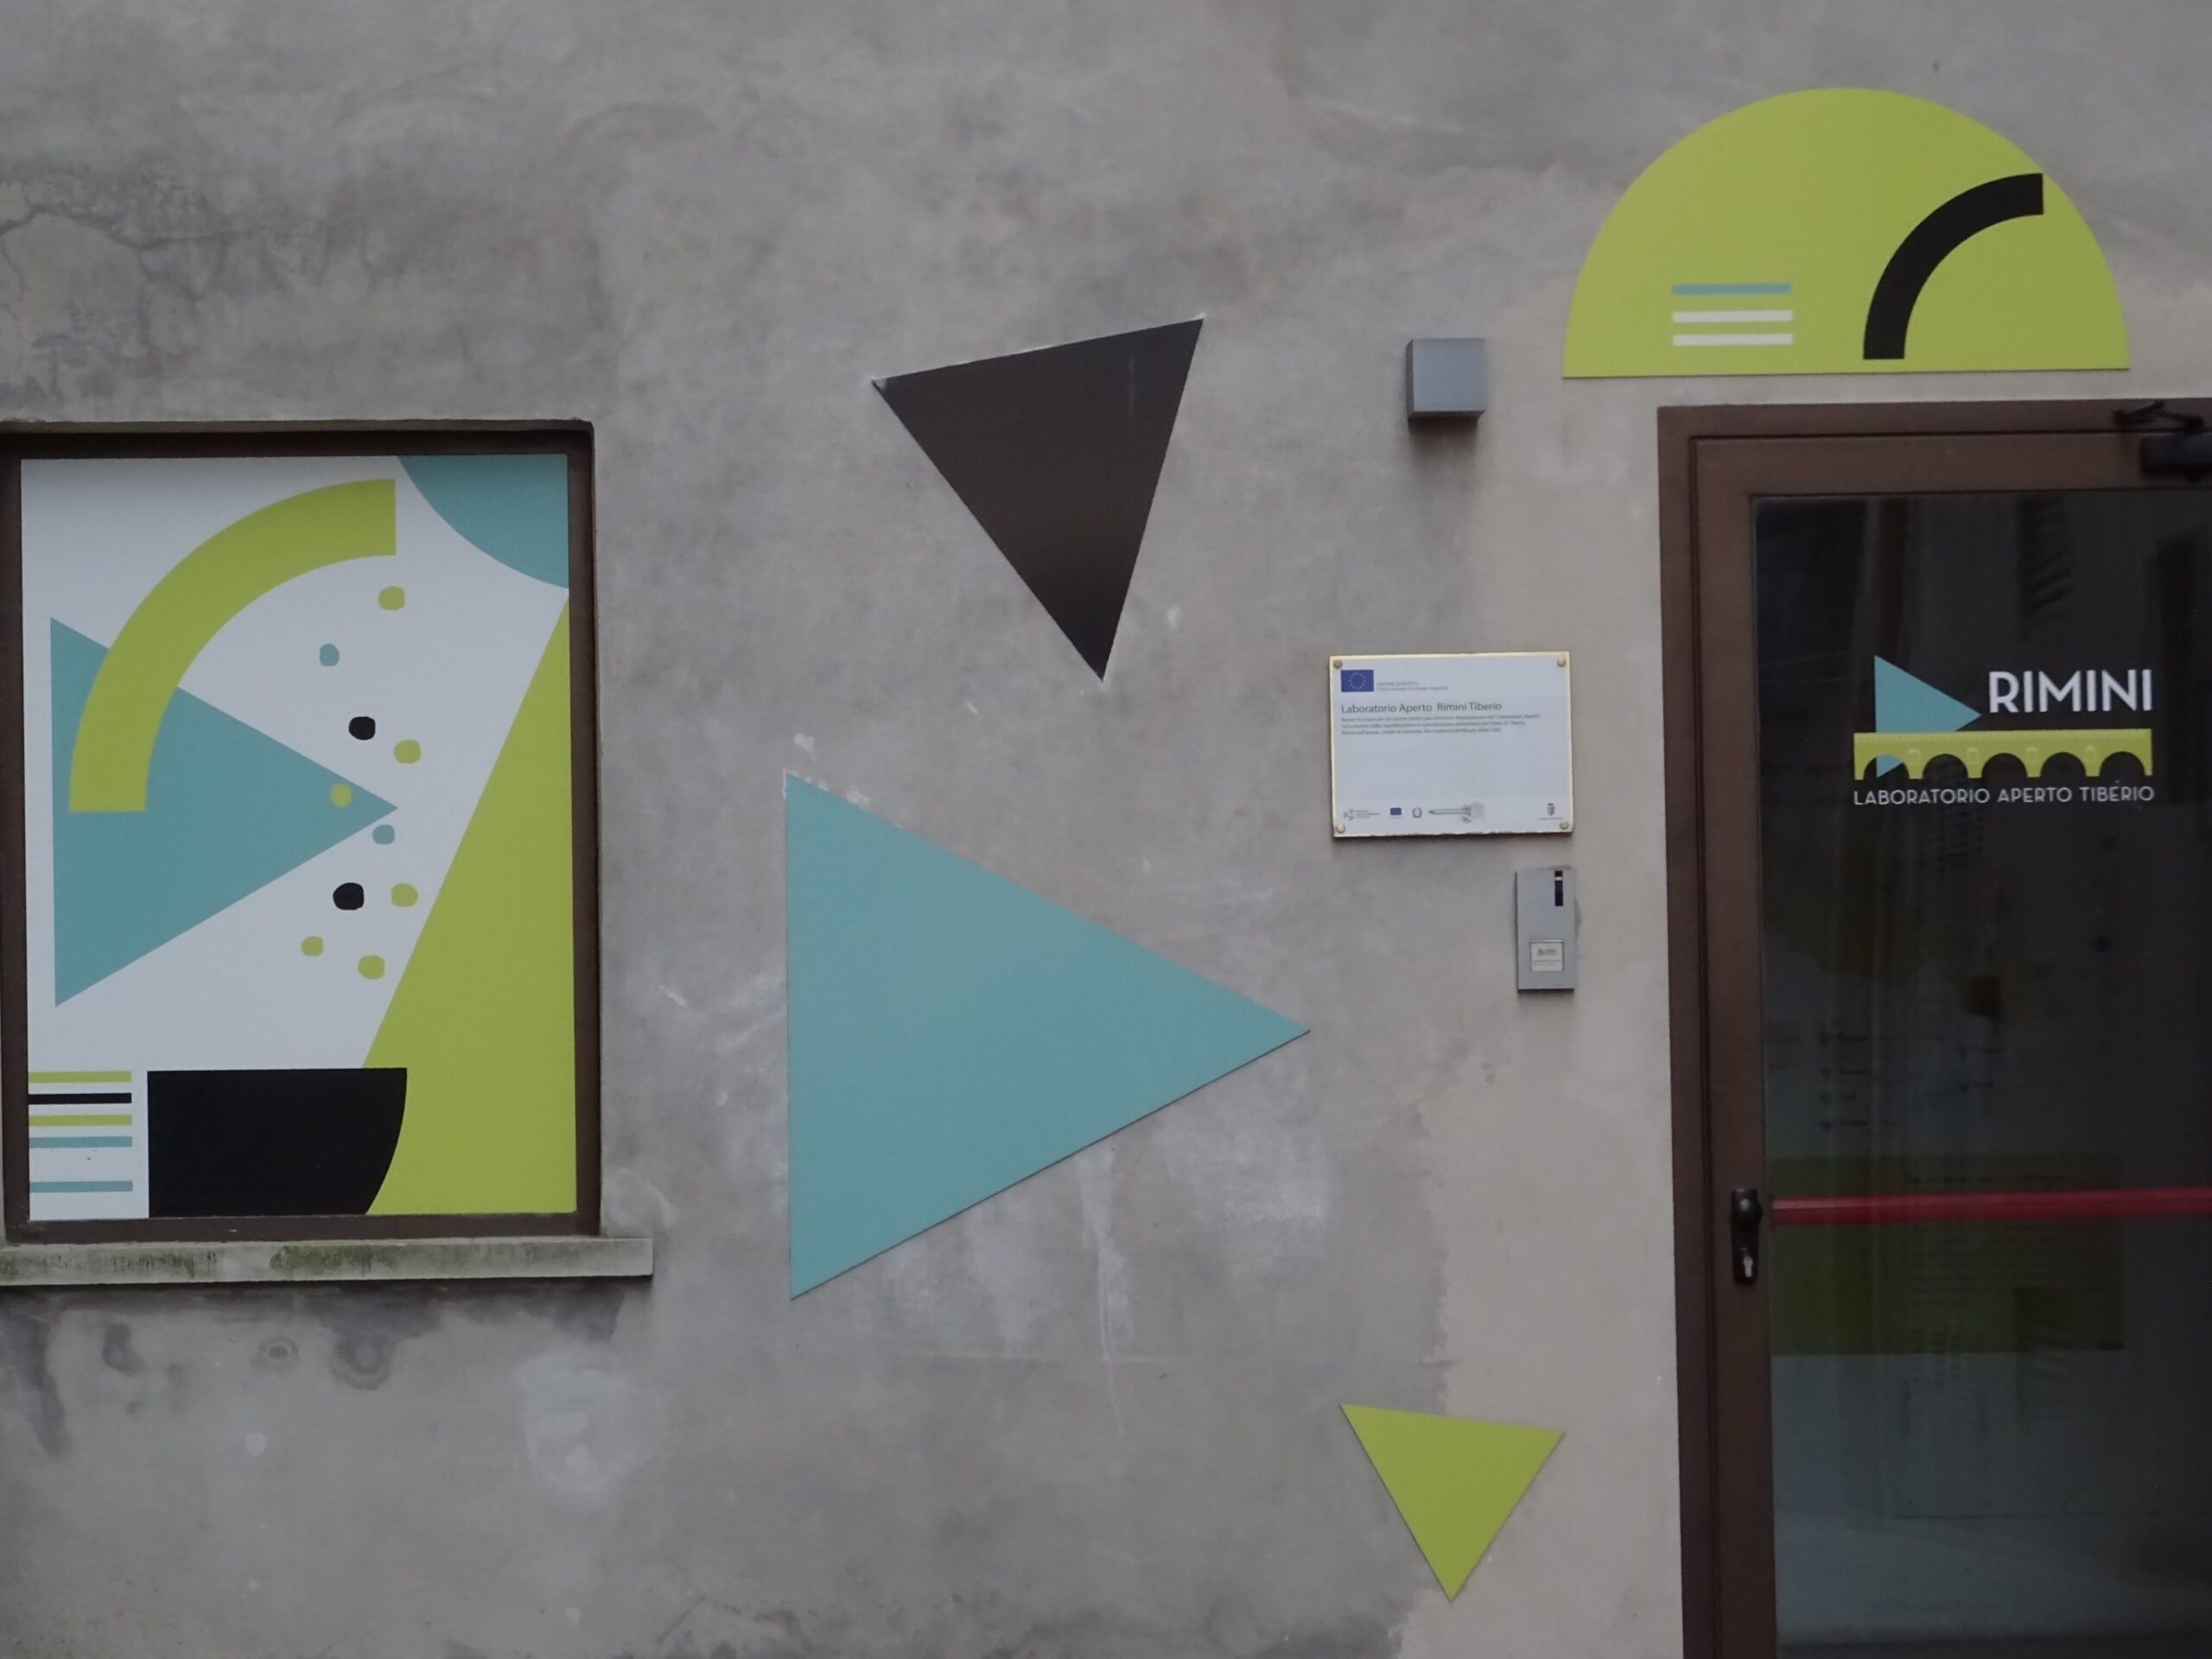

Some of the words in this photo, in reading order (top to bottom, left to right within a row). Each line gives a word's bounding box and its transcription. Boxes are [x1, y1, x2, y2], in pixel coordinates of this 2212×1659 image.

[1989, 669, 2152, 713] RIMINI
[1341, 703, 1397, 714] Laboratorio
[1399, 702, 1433, 714] Aperto
[1437, 702, 1467, 712] Rimini
[1469, 701, 1503, 711] Tiberio
[1853, 789, 1990, 805] LABORATORIO
[1997, 787, 2073, 804] APERTO
